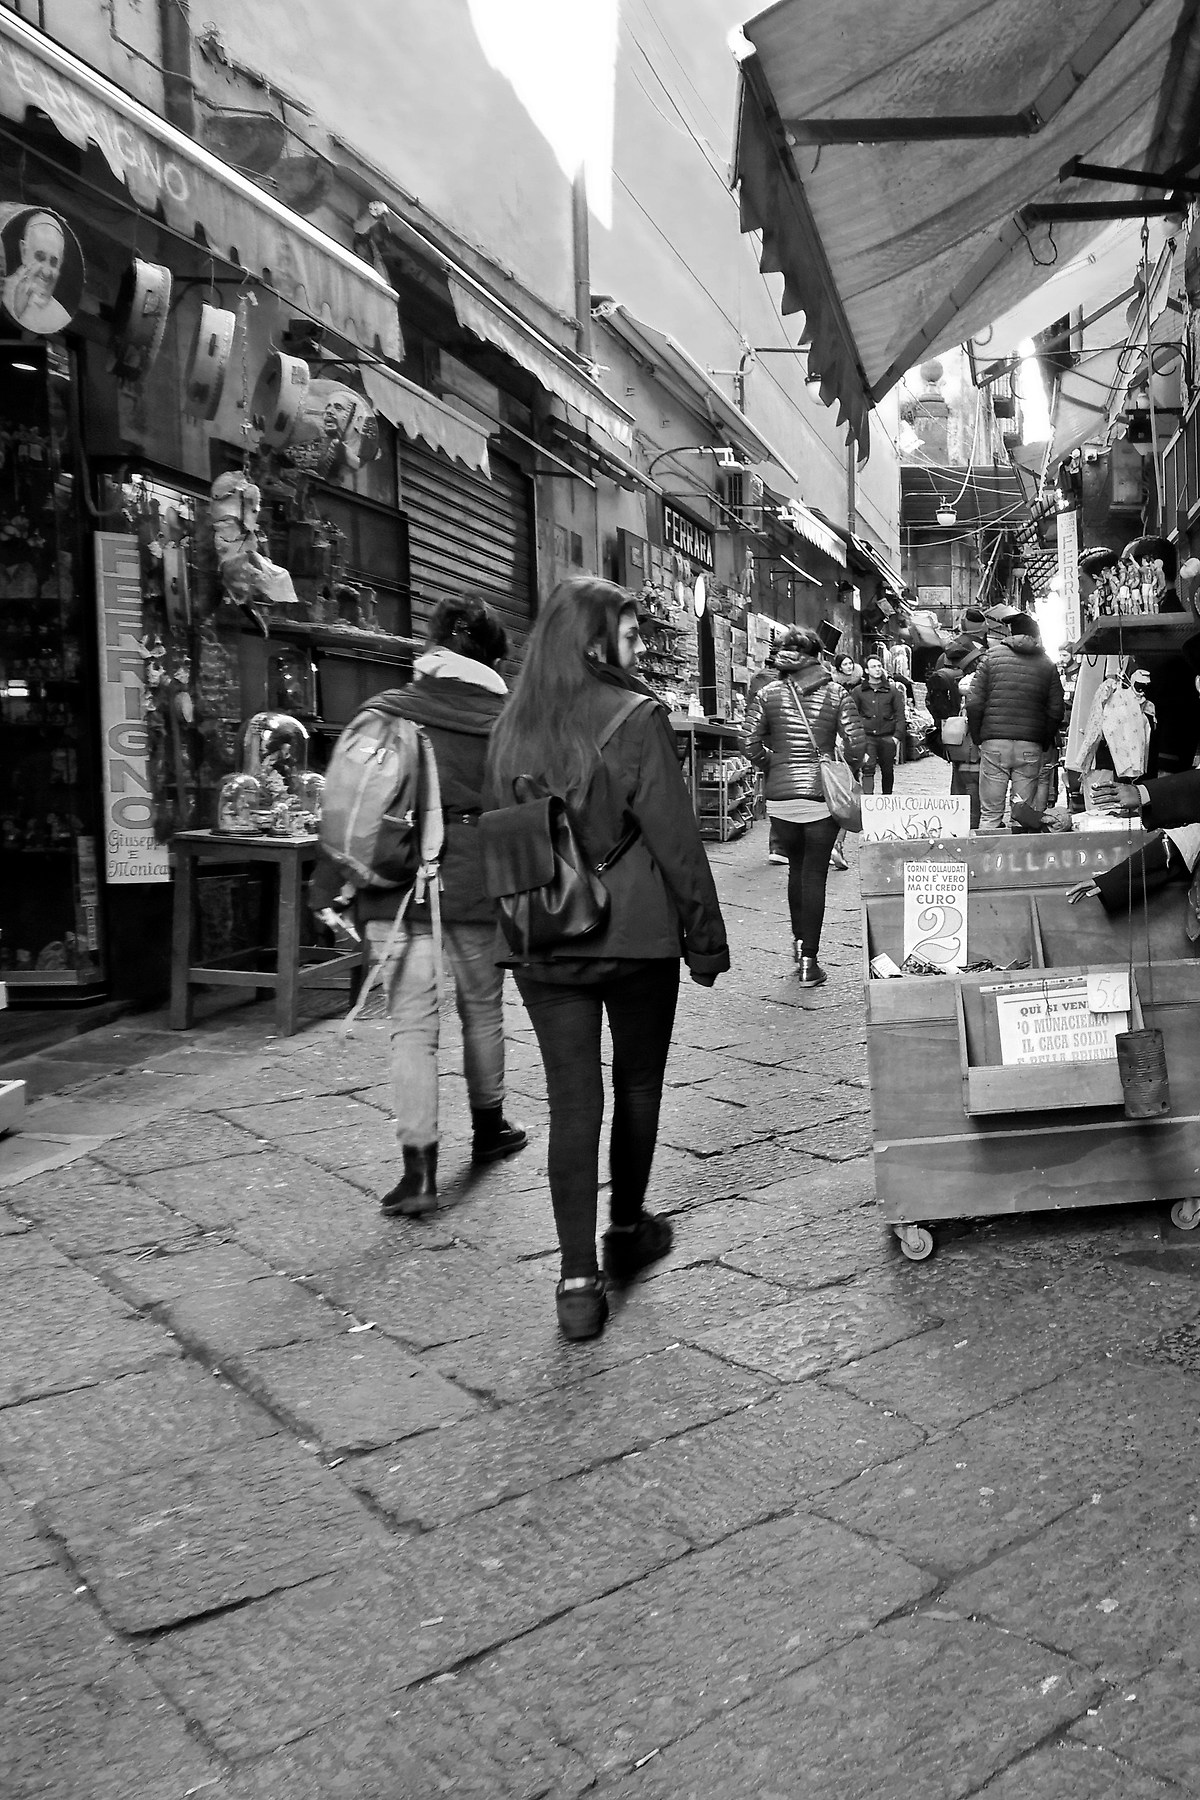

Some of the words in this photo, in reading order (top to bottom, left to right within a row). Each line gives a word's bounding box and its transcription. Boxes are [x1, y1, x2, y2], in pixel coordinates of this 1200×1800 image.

[0, 42, 189, 201] ERRIGNO
[663, 505, 714, 568] FERRARA
[1062, 534, 1077, 641] FERRIGN
[101, 537, 155, 830] FERRIGNO
[108, 830, 172, 857] Giusep
[907, 865, 927, 873] CORNI
[907, 875, 929, 883] NON
[942, 875, 966, 883] VERO
[907, 884, 921, 892] MA
[924, 884, 933, 892] CI
[935, 884, 965, 892] CREDO
[912, 905, 963, 965] 2
[1046, 1004, 1058, 1013] SI
[1061, 1000, 1088, 1011] VEN
[1022, 1039, 1035, 1054] IL
[1039, 1034, 1069, 1052] CACA
[1073, 1030, 1109, 1047] SOLDI
